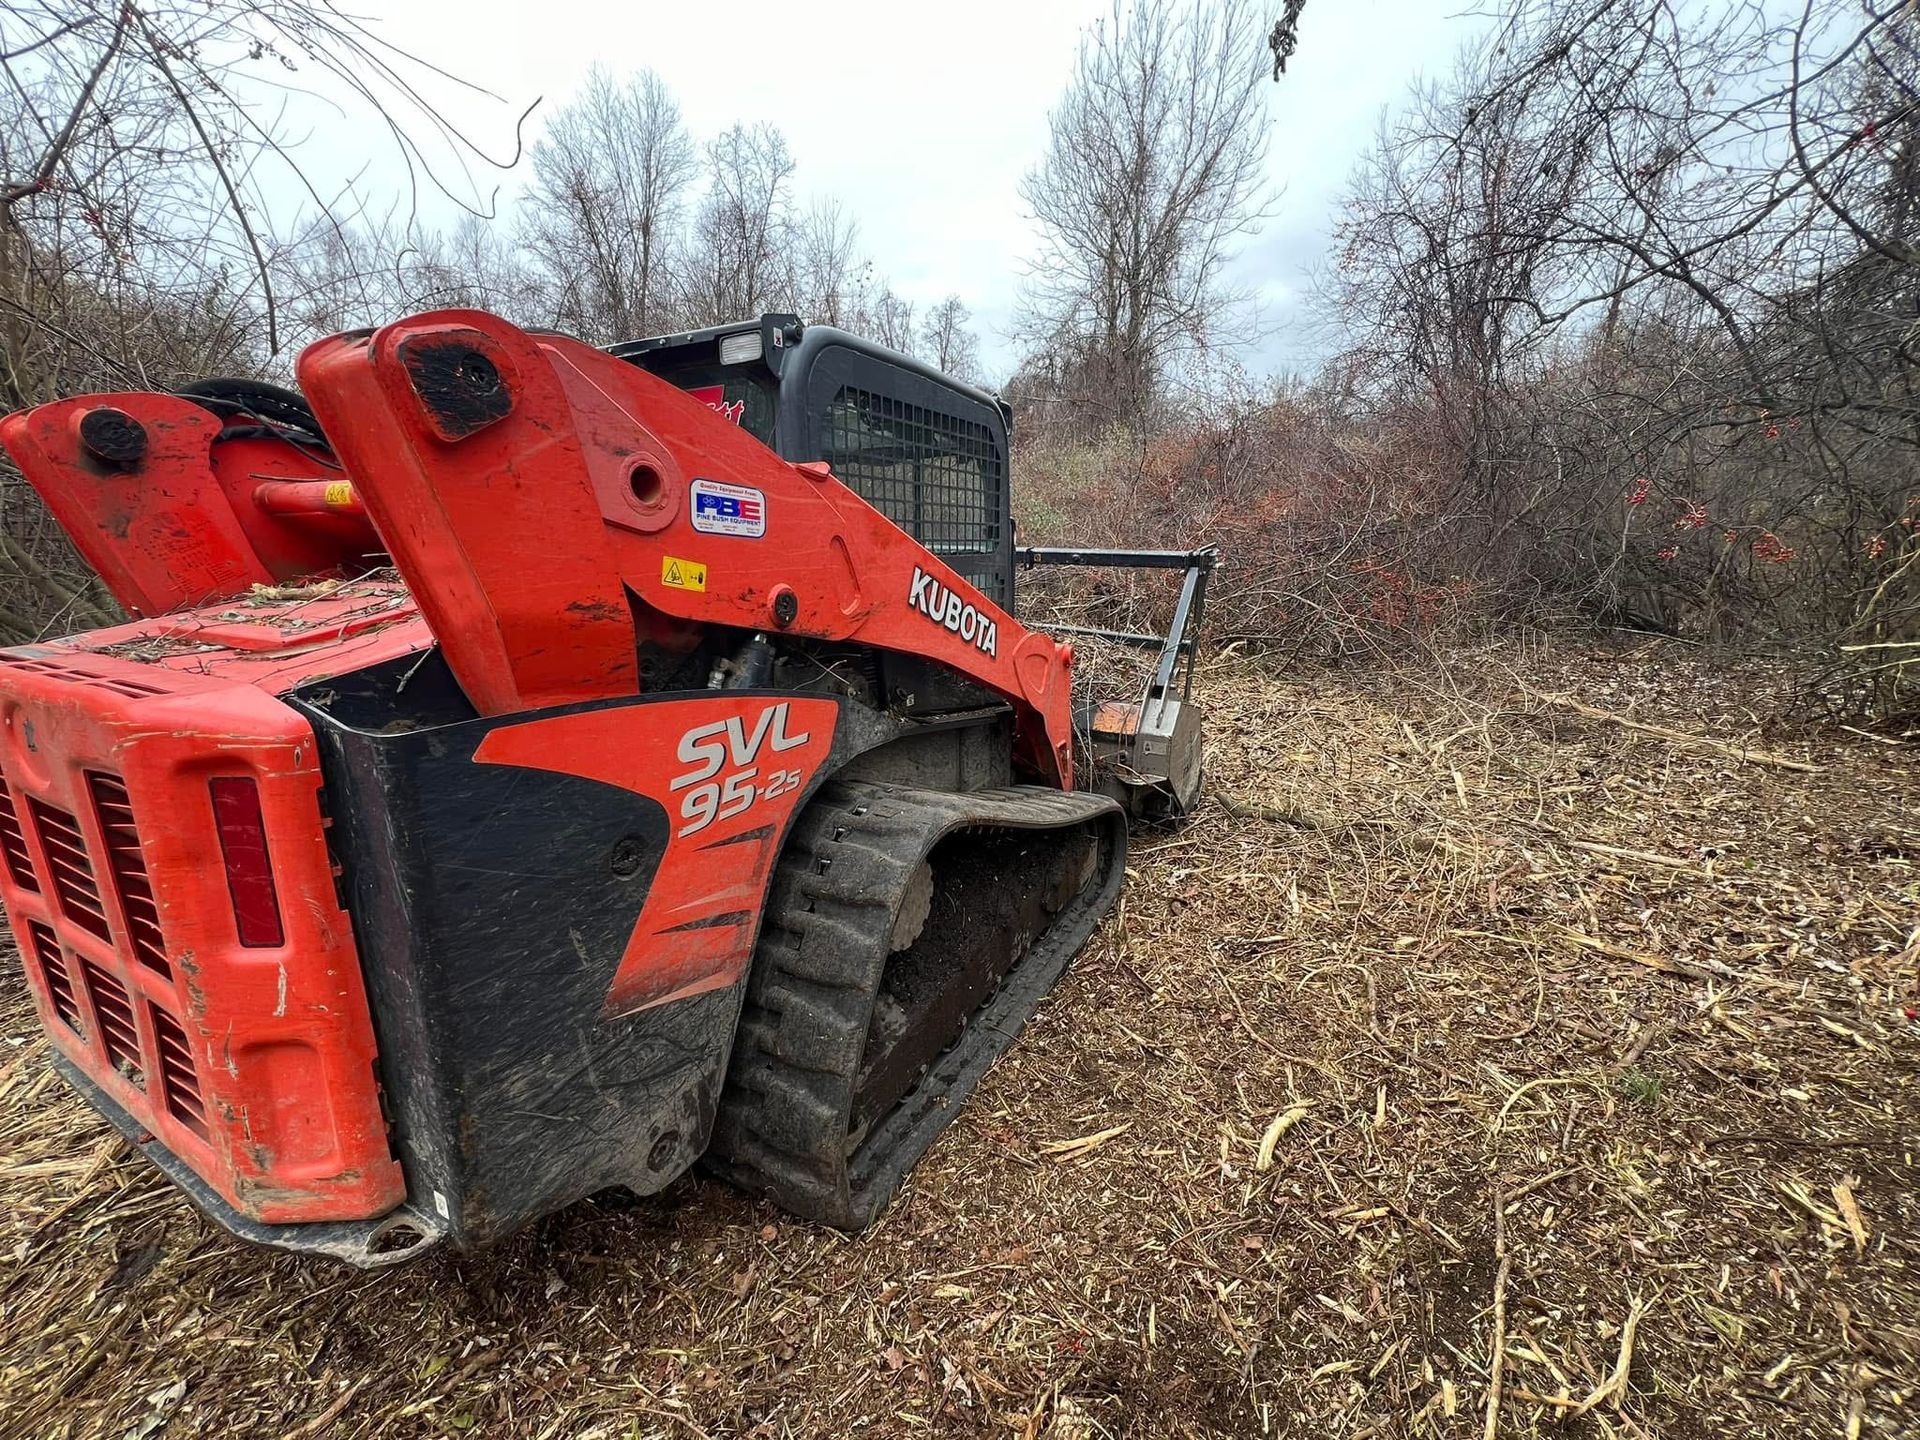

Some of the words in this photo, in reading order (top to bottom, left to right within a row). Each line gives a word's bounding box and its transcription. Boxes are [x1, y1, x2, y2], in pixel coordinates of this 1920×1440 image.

[719, 486, 743, 494] Equipment
[696, 493, 761, 520] PBE
[729, 518, 761, 526] EQUIPMENT
[908, 566, 997, 657] KUBOTA
[670, 702, 810, 791] SVL
